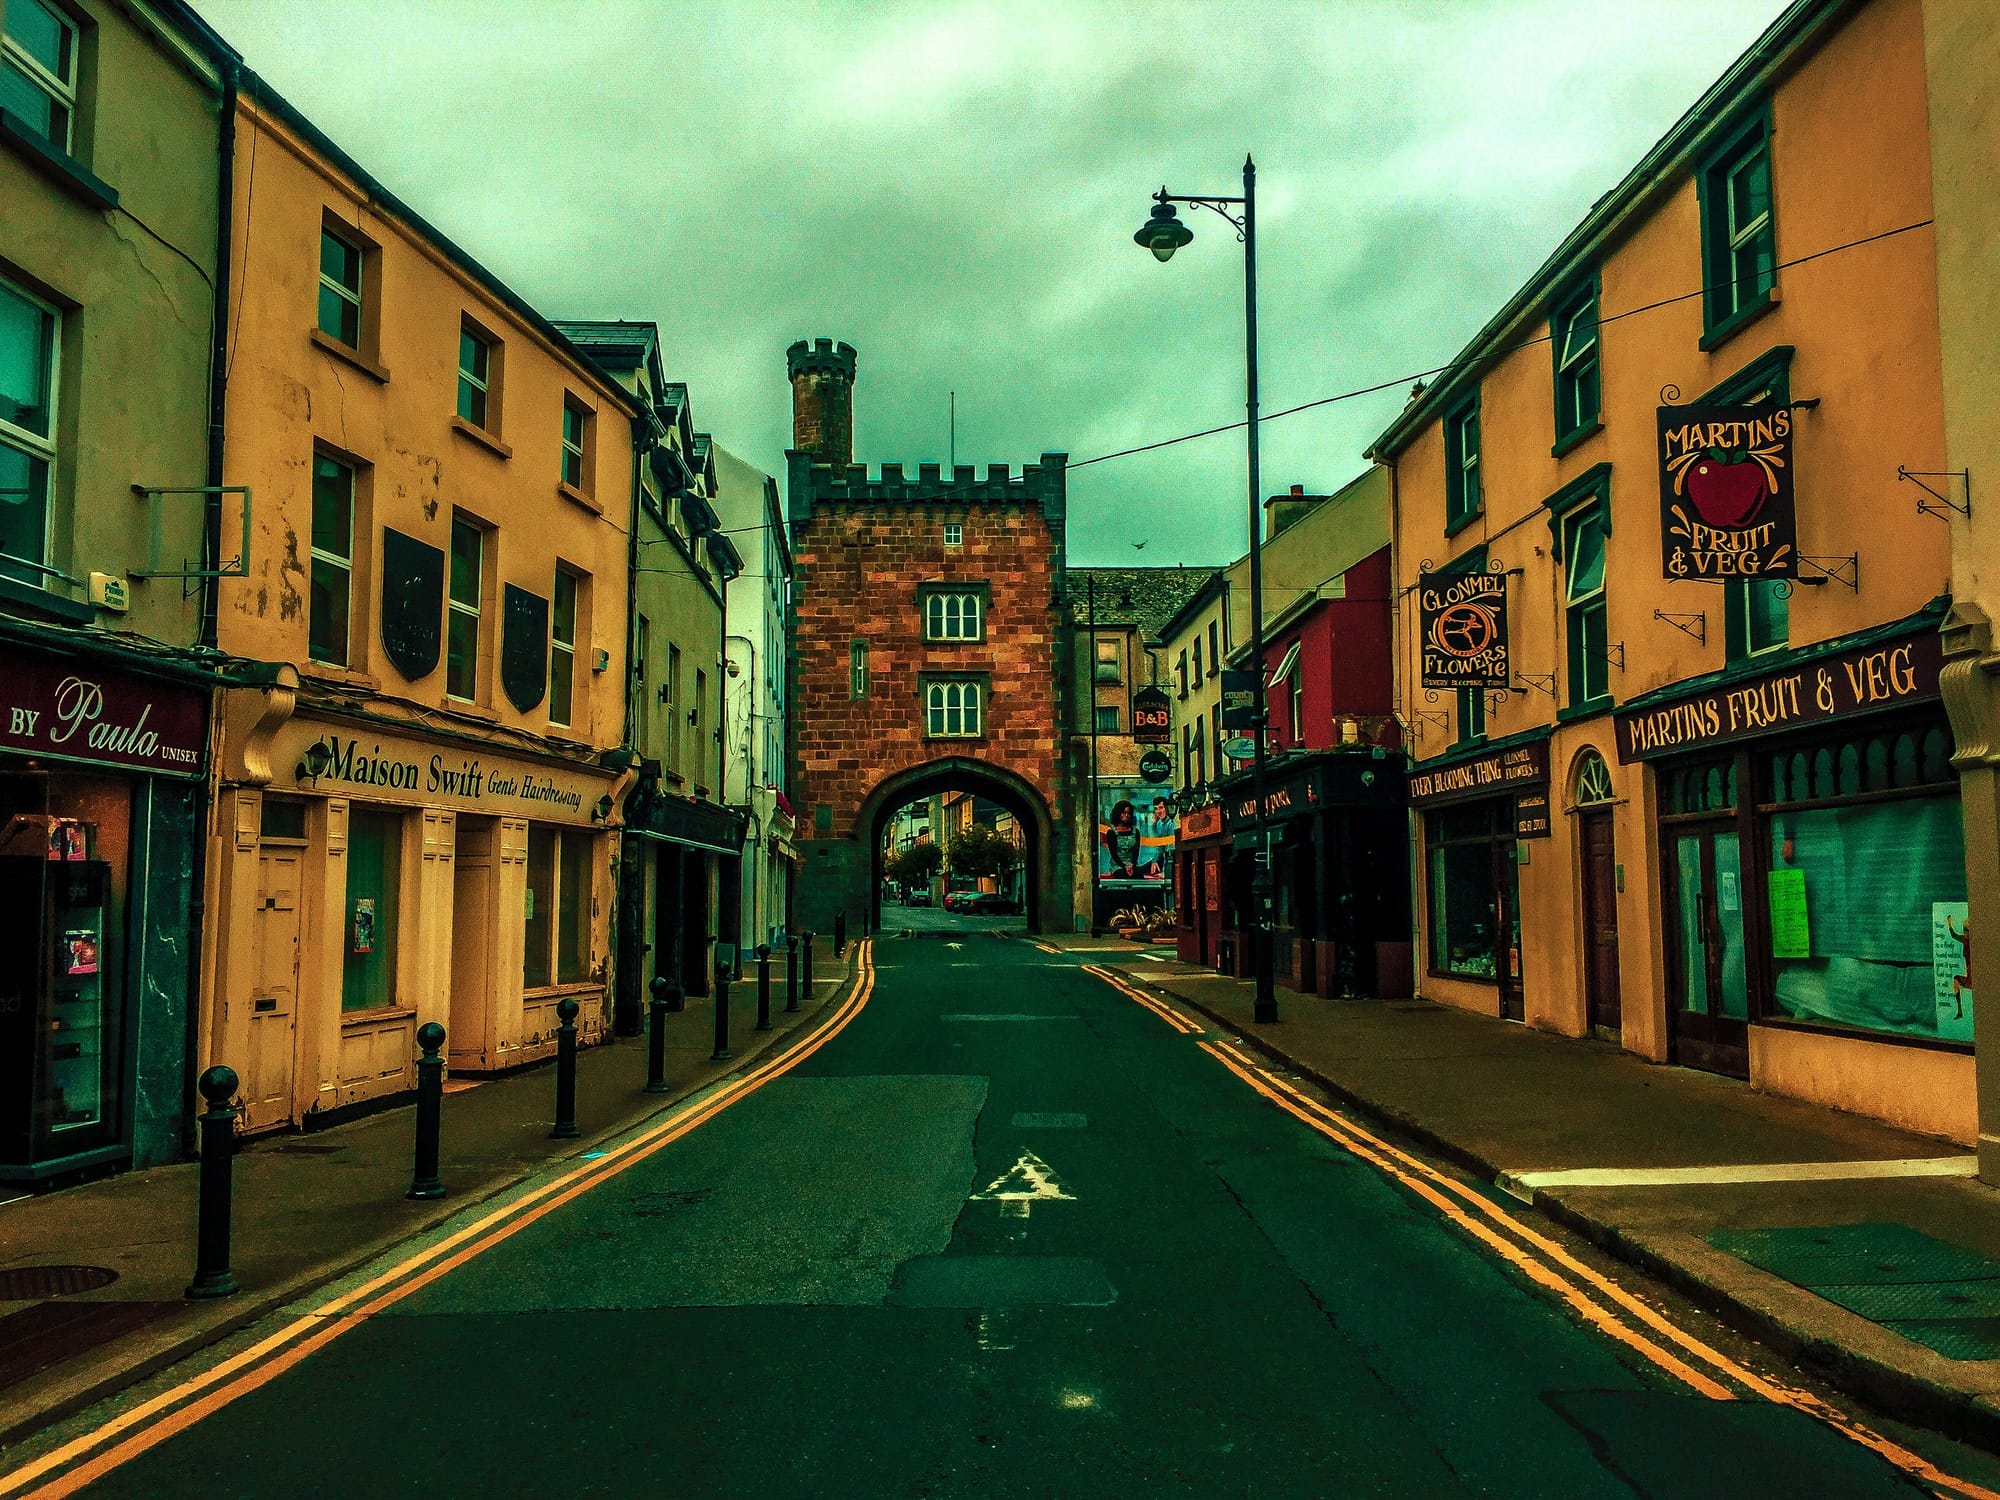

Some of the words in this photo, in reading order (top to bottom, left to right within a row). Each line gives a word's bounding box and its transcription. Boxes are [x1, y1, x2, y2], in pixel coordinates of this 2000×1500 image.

[1665, 410, 1790, 459] MARTINS
[1692, 521, 1775, 553] FRUIT
[1668, 546, 1689, 576] &
[1690, 551, 1761, 575] VEG
[1423, 576, 1505, 612] CLONMEL
[1424, 645, 1507, 675] FLOWERS
[1629, 699, 1720, 754] MARTINS
[1726, 674, 1802, 732] FRUIT
[1816, 667, 1834, 714] &
[1843, 643, 1917, 704] VEG
[8, 707, 40, 737] BY
[50, 676, 160, 757] Paula
[161, 746, 198, 764] UNISEX
[1134, 710, 1169, 727] B&B
[326, 736, 419, 790] Maison
[427, 754, 484, 799] Swift
[487, 769, 518, 796] Gents
[521, 775, 582, 813] Hairdressing
[1410, 776, 1433, 798] EVERY
[1434, 765, 1475, 793] BLOOMING
[1474, 758, 1502, 785] THING
[1505, 763, 1533, 780] FLOWERS
